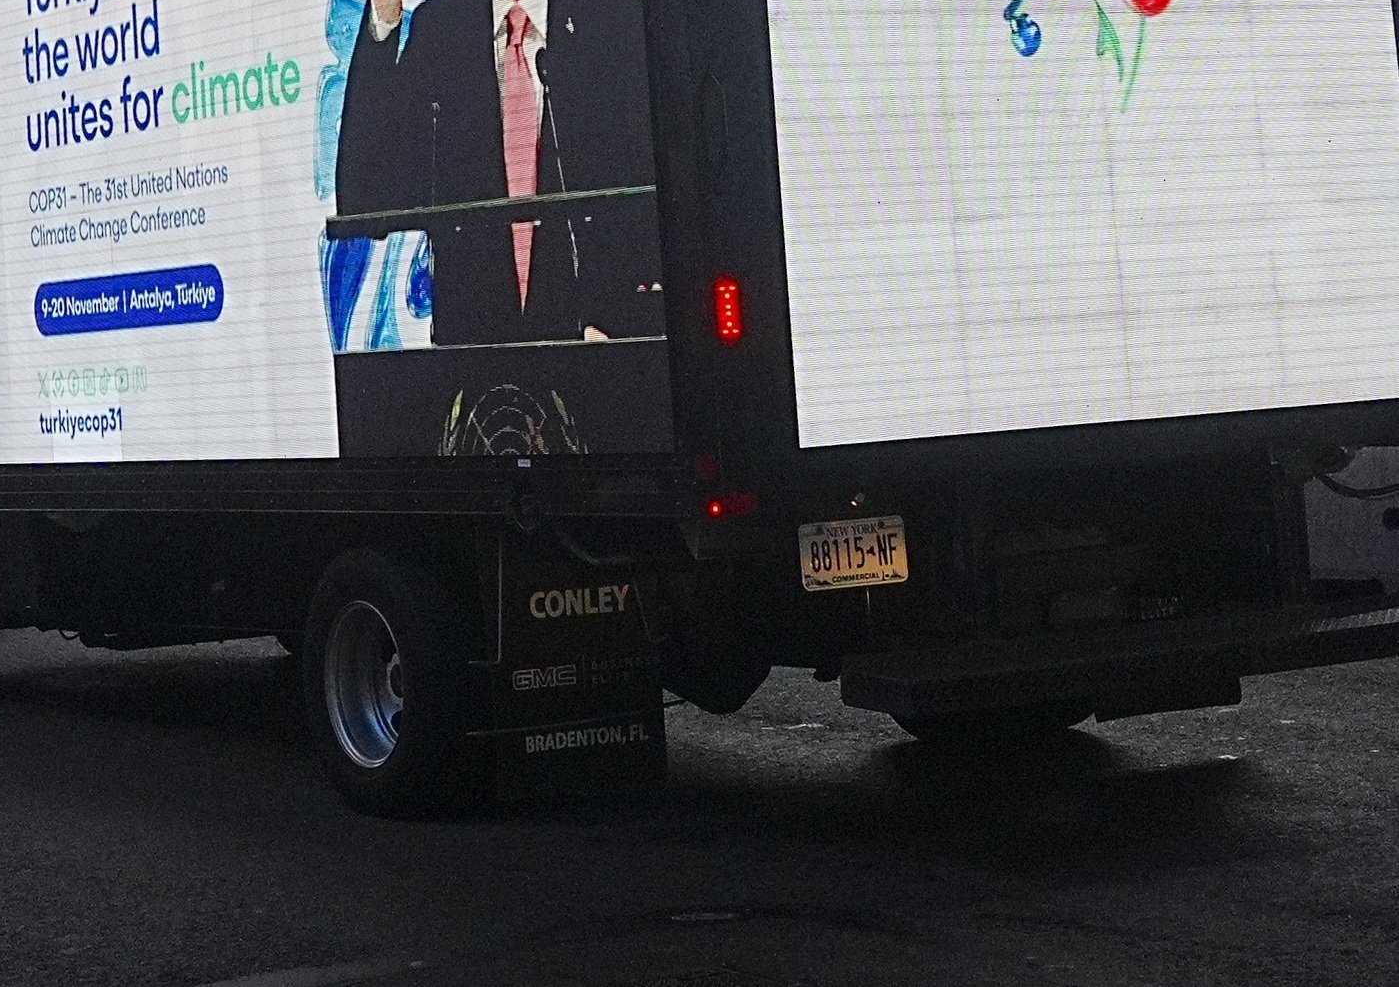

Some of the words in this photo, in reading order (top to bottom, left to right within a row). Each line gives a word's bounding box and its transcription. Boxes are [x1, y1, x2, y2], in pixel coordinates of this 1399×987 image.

[22, 27, 69, 84] the
[26, 90, 113, 151] unites
[120, 75, 164, 133] for
[171, 51, 301, 124] climate
[28, 185, 68, 213] COP31
[80, 180, 103, 205] The
[105, 175, 129, 200] 31st
[131, 169, 173, 198] United
[176, 164, 228, 190] Nations
[30, 219, 76, 248] Climate
[79, 213, 127, 243] Change
[131, 205, 206, 236] Conference
[41, 299, 65, 319] 9-20
[66, 292, 120, 317] November
[130, 287, 174, 311] Antalya,
[175, 283, 216, 307] Türkiye
[39, 407, 123, 439] turkiyecop31
[827, 528, 849, 537] NEW
[851, 523, 878, 535] YORK
[832, 572, 880, 583] COMMERCIAL
[529, 584, 630, 619] CONLEY
[512, 664, 577, 691] GMC
[525, 725, 626, 754] BRADENTON,
